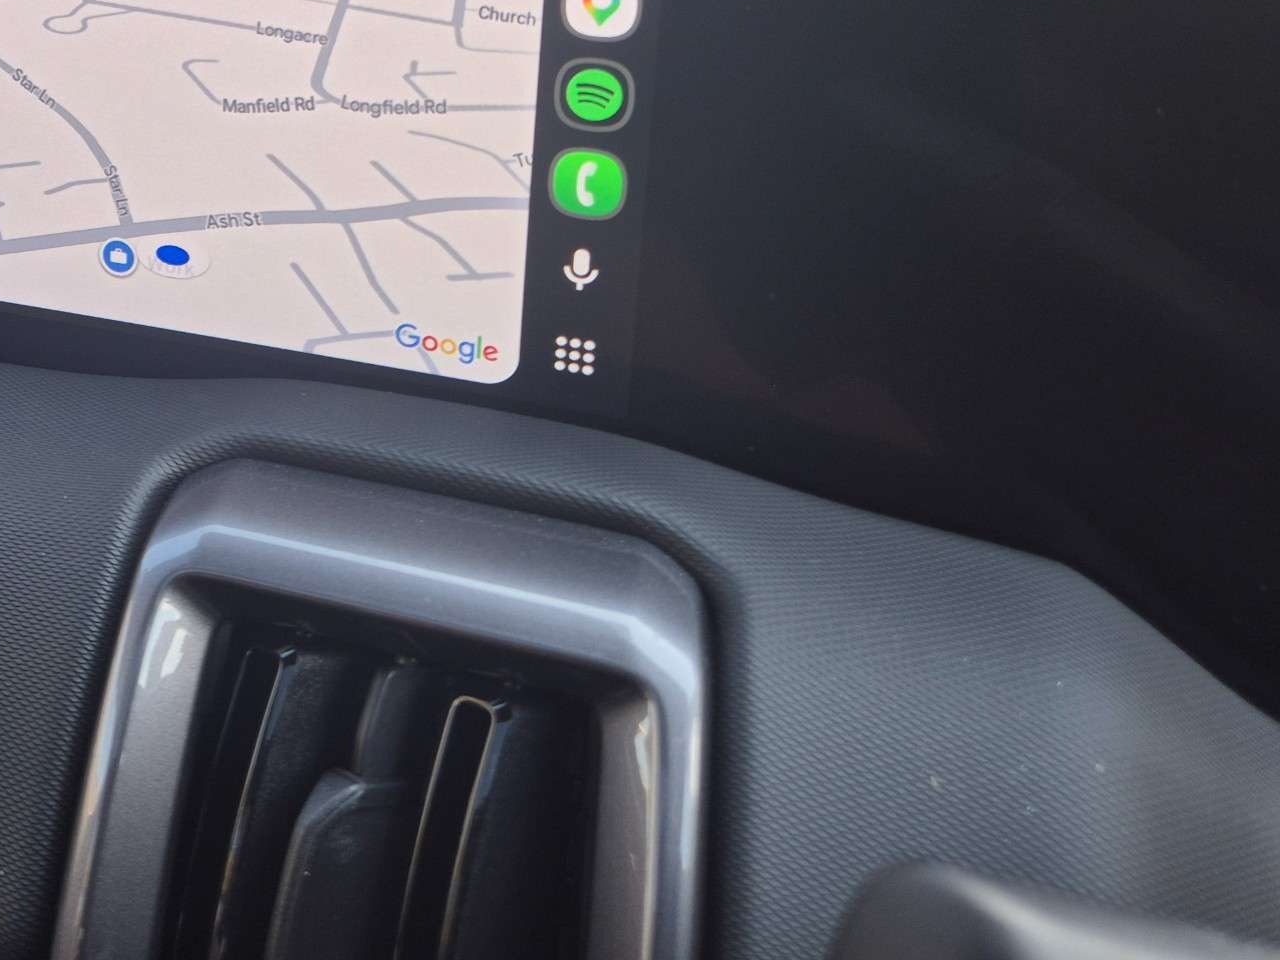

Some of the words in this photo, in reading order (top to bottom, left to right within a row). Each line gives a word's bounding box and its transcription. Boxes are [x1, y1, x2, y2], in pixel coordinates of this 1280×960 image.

[478, 5, 536, 26] Church
[256, 21, 328, 46] Longacre
[12, 68, 39, 97] Star
[39, 89, 56, 109] Ln
[222, 97, 291, 115] Manfield
[294, 95, 316, 113] Rd
[340, 94, 420, 118] Longfield
[424, 98, 448, 115] Rd
[104, 164, 123, 196] Star
[116, 198, 130, 217] Ln
[206, 213, 240, 230] Ash
[242, 211, 263, 228] St
[394, 323, 500, 364] Google
